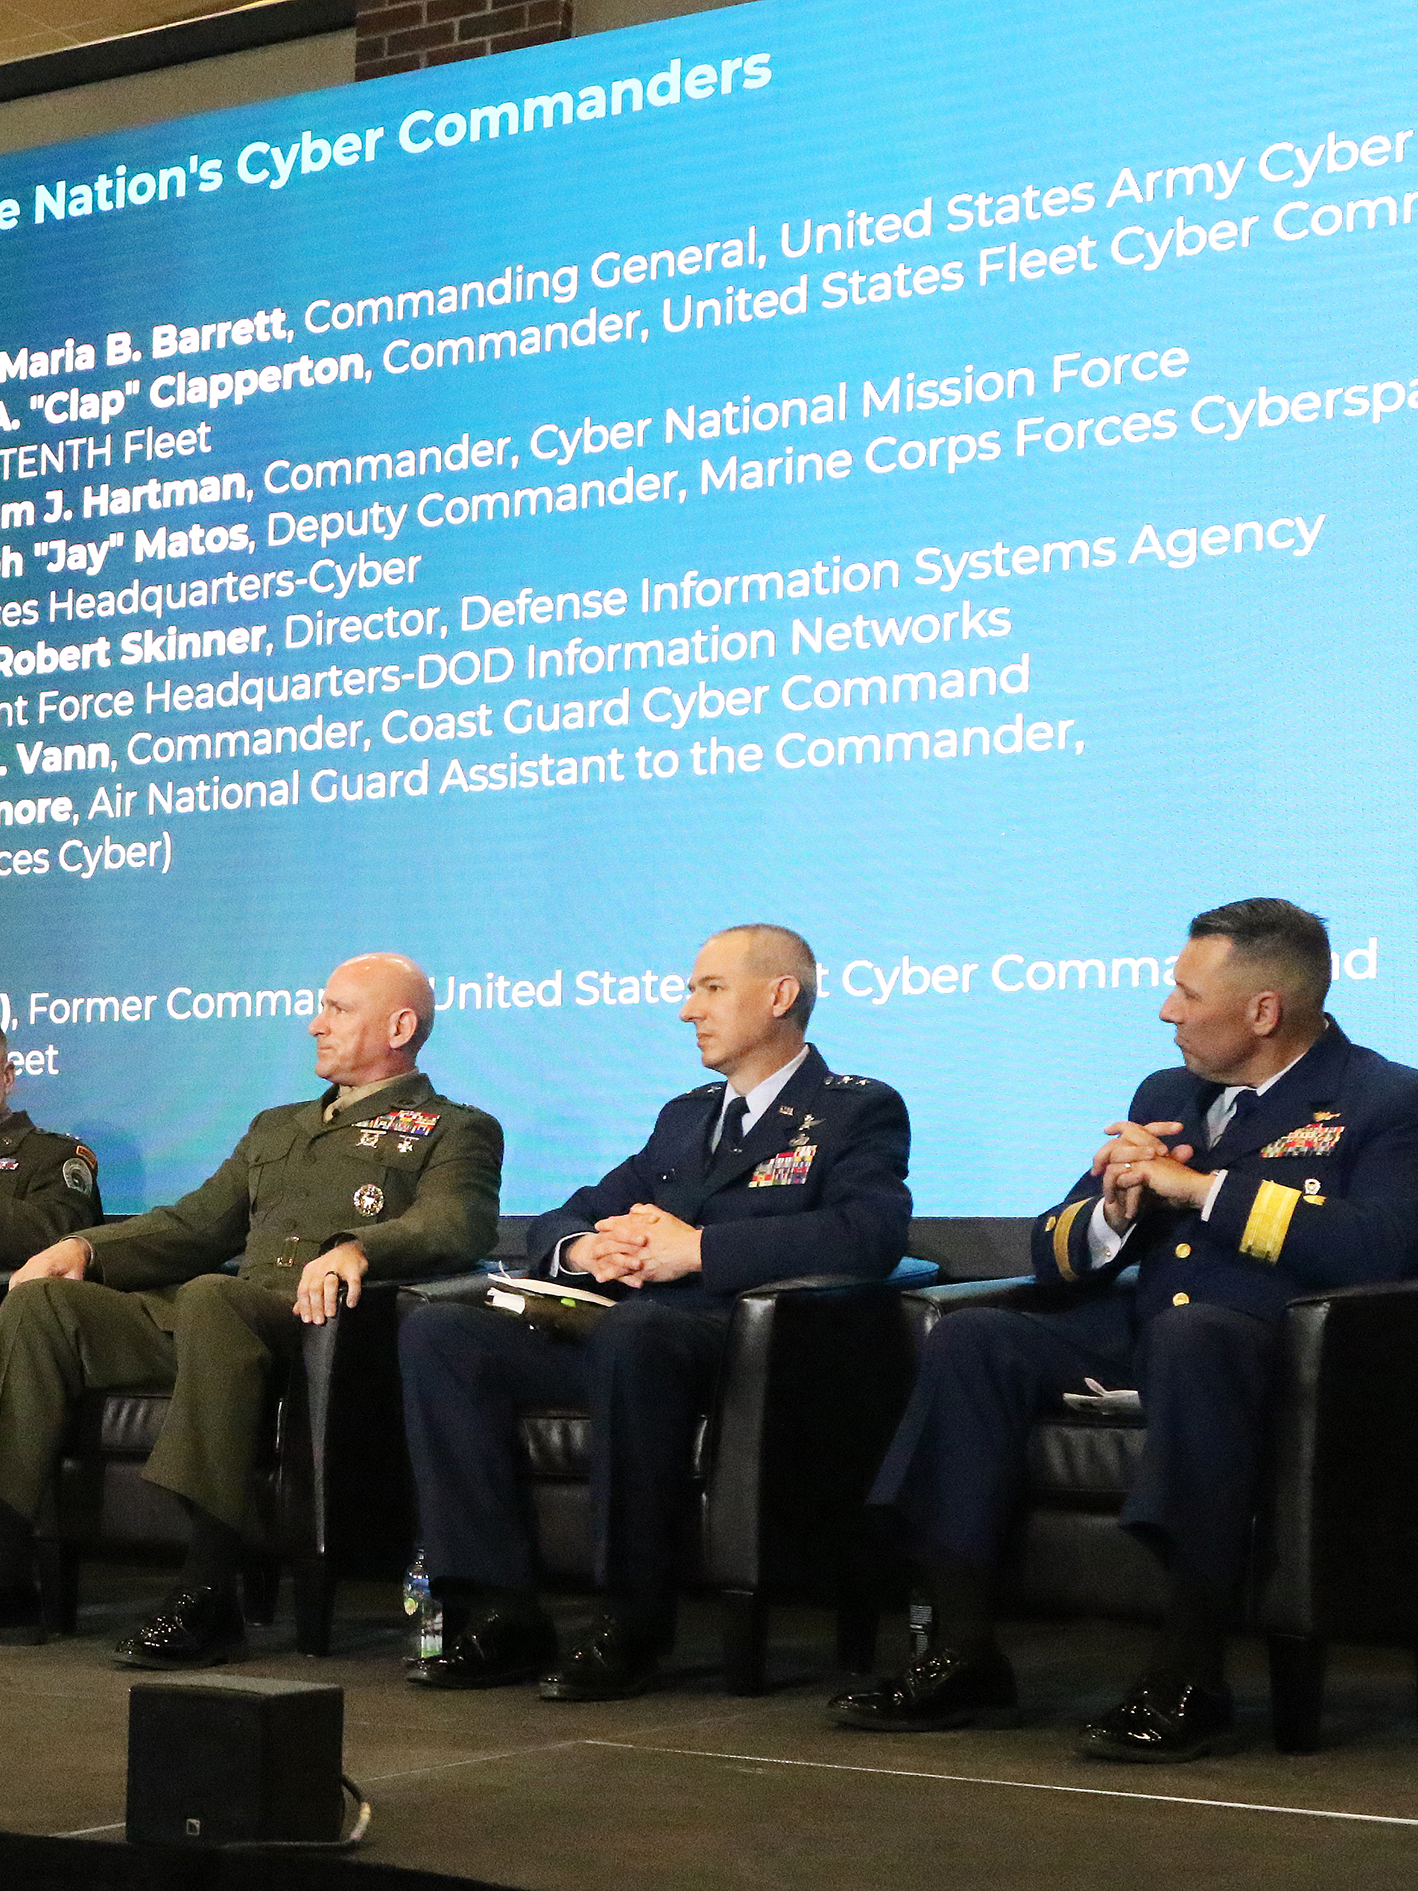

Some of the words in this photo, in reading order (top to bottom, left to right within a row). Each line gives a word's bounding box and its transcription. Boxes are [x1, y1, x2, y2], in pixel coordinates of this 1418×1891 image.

[34, 154, 223, 224] Nation's
[237, 126, 385, 190] Cyber
[398, 52, 772, 154] Commanders
[29, 378, 141, 425] "Clap"
[149, 352, 373, 409] Clapperton,
[382, 306, 650, 375] Commander,
[662, 273, 809, 333] United
[821, 260, 965, 310] States
[978, 234, 1099, 287] Fleet
[1110, 215, 1260, 272] Cyber
[1272, 190, 1418, 242] Com
[106, 331, 143, 367] B.
[151, 307, 295, 360] Barrett,
[304, 263, 579, 334] Commanding
[590, 225, 767, 289] General,
[780, 196, 933, 259] United
[946, 181, 1096, 233] States
[1105, 156, 1247, 209] Army
[1258, 129, 1415, 189] Cyber
[33, 531, 125, 576] "Jay"
[134, 523, 256, 563] Matos,
[267, 501, 409, 549] Deputy
[416, 465, 687, 528] Commander,
[700, 445, 853, 495] Marine
[864, 429, 1002, 474] Corps
[1016, 408, 1179, 457] Forces
[43, 489, 73, 524] J.
[83, 472, 254, 519] Hartman,
[263, 432, 520, 494] Commander,
[529, 416, 653, 466] Cyber
[665, 381, 847, 444] National
[862, 363, 1036, 418] Mission
[1052, 346, 1191, 393] Force
[124, 421, 212, 464] Fleet
[49, 552, 423, 623] Headquarters-Cyber
[120, 624, 274, 666] Skinner,
[285, 605, 448, 649] Director,
[460, 587, 628, 632] Defense
[641, 554, 900, 613] Information
[914, 536, 1118, 593] Systems
[1127, 513, 1327, 570] Agency
[15, 740, 118, 775] Vann,
[127, 714, 372, 766] Commander,
[381, 703, 494, 745] Coast
[503, 686, 630, 735] Guard
[642, 680, 771, 730] Cyber
[781, 652, 1031, 712] Command
[38, 690, 135, 724] Force
[145, 646, 515, 714] Headquarters-DOD
[527, 624, 776, 680] Information
[791, 599, 1012, 656] Networks
[87, 782, 138, 821] Air
[148, 769, 300, 816] National
[310, 758, 430, 803] Guard
[438, 747, 626, 795] Assistant
[634, 745, 680, 780] to
[689, 736, 765, 776] the
[775, 712, 1086, 770] Commander,
[58, 830, 172, 880] Cyber)
[29, 992, 158, 1025] Former
[166, 986, 326, 1020] Comma
[428, 969, 563, 1012] United
[575, 969, 694, 1006] State
[842, 955, 980, 1005] Cyber
[991, 936, 1379, 992] Commd
[7, 1044, 60, 1077] eet
